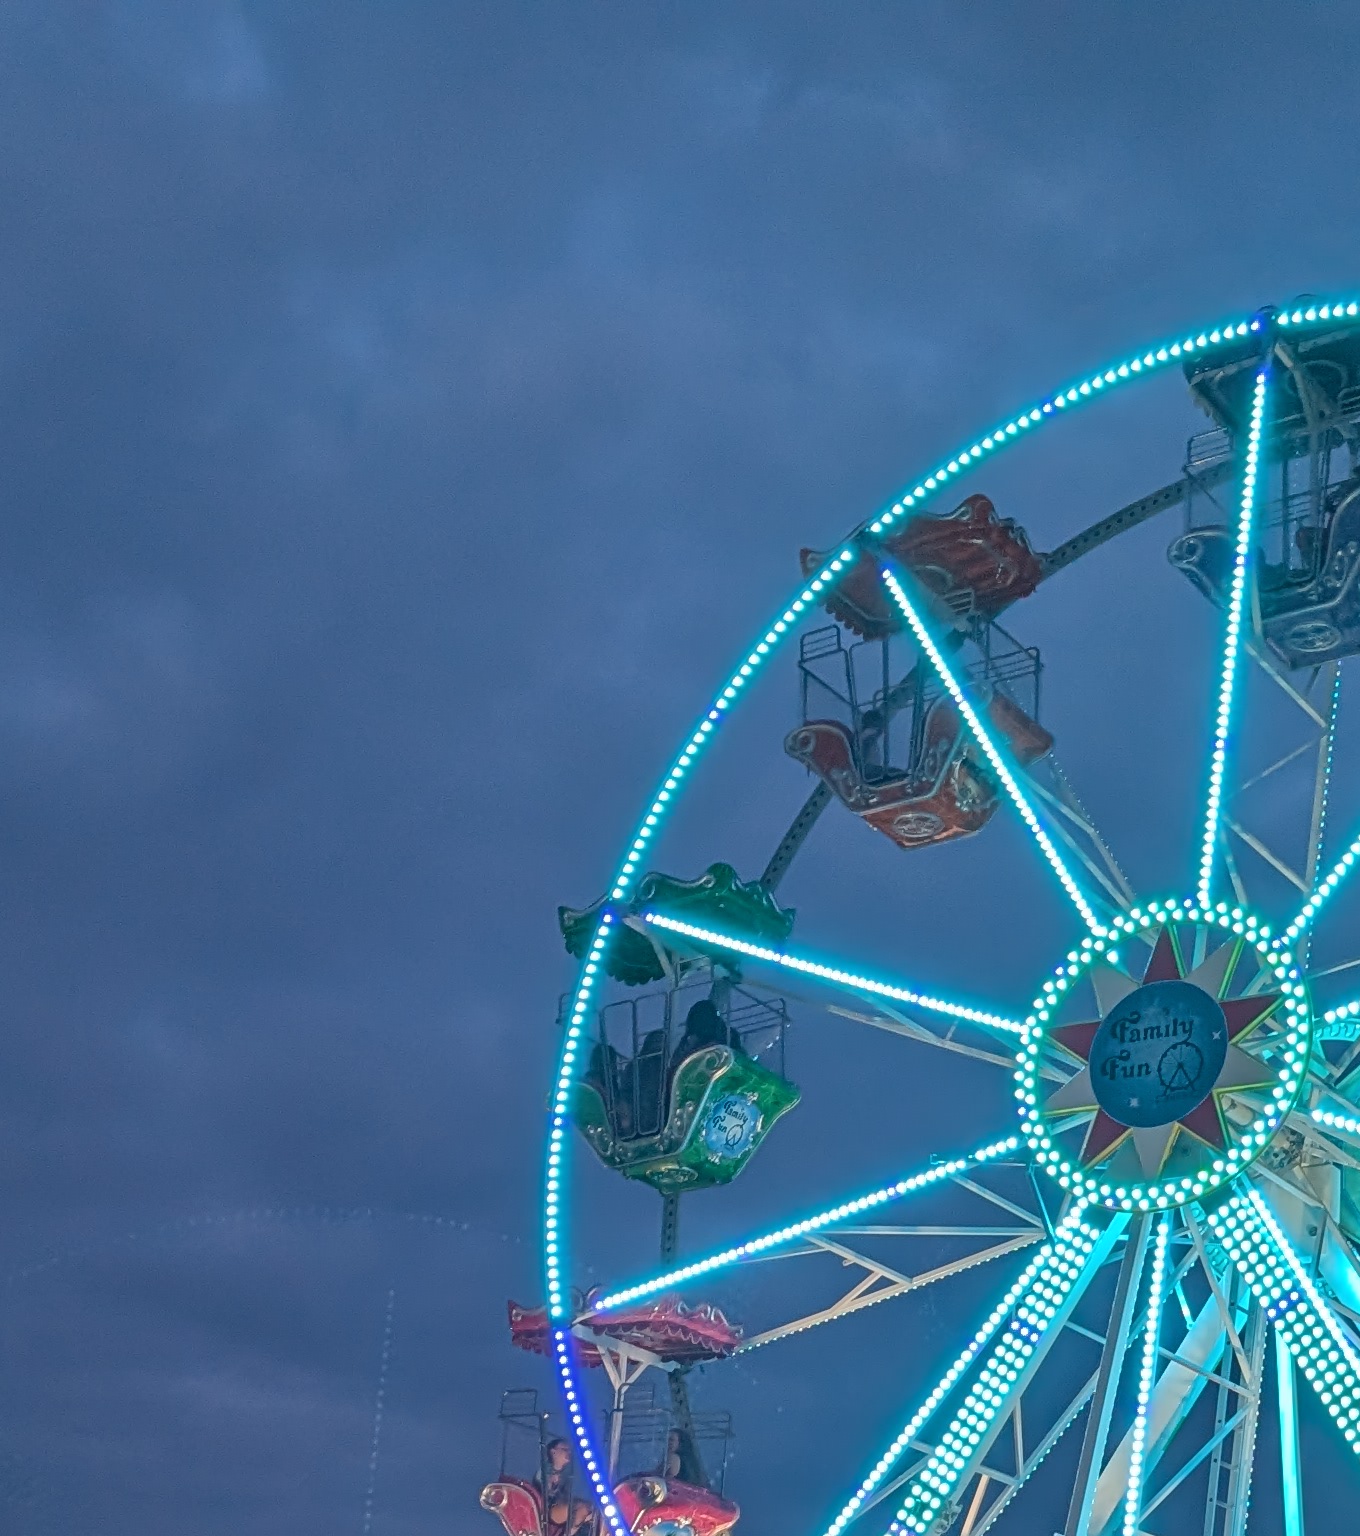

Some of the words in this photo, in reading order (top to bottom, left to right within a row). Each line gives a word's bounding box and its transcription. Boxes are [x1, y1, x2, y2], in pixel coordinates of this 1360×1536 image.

[1109, 1008, 1195, 1044] Family
[1100, 1049, 1152, 1081] Fun
[712, 1115, 728, 1133] Fun
[724, 1100, 749, 1124] Family
